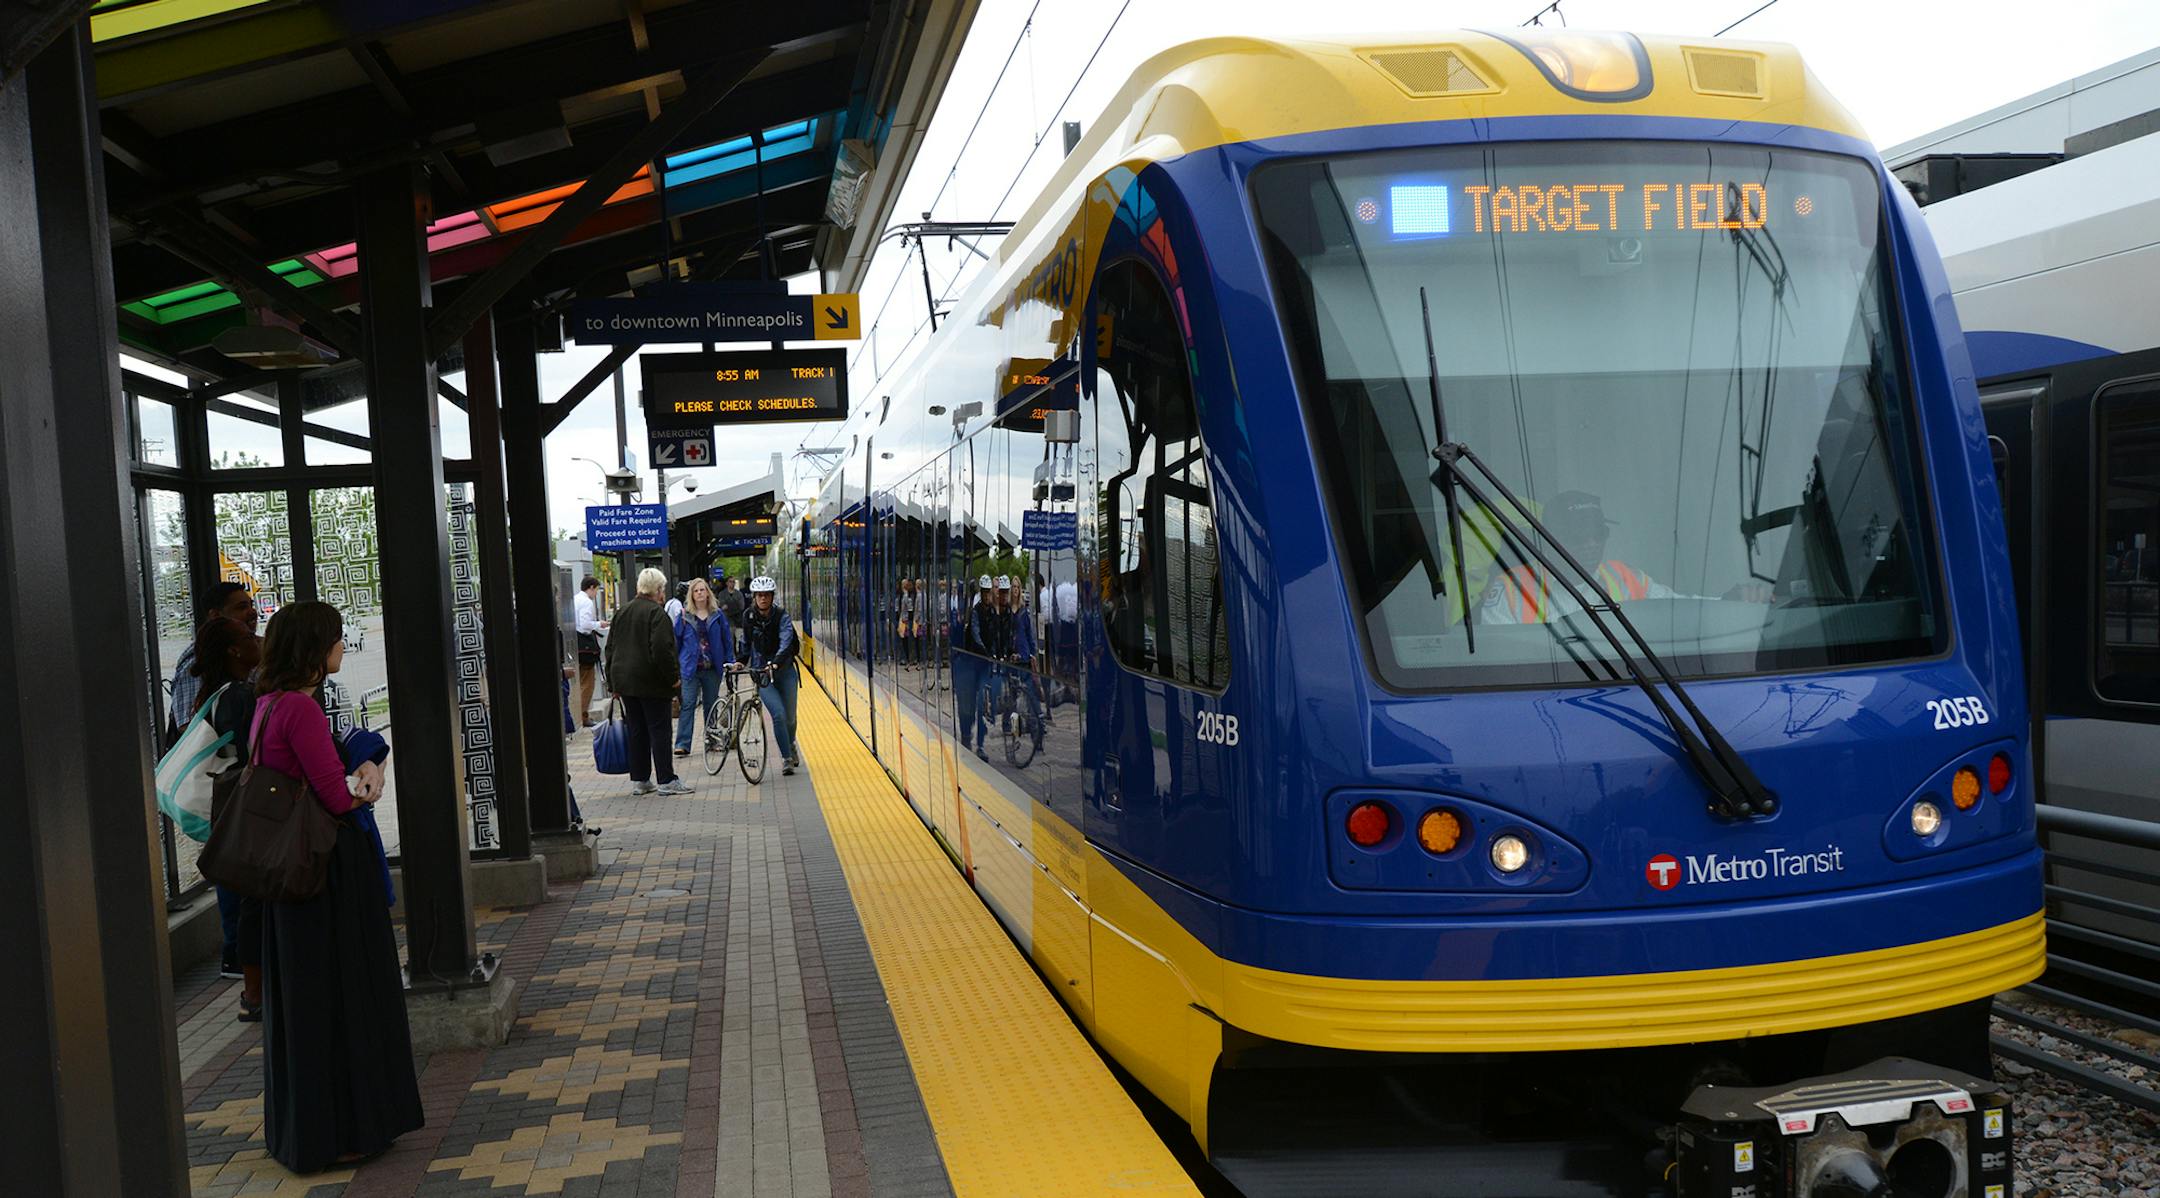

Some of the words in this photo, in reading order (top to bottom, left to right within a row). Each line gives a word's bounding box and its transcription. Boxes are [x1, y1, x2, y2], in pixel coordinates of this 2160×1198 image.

[1464, 184, 1624, 233] TARGET
[1643, 184, 1767, 231] FIELD
[585, 316, 604, 330] to
[610, 314, 700, 330] downtown
[706, 311, 804, 331] Minneapolis
[716, 369, 739, 382] 8:55
[744, 369, 760, 380] AM
[791, 367, 825, 379] TRACK
[674, 401, 714, 413] PLEASE
[719, 399, 753, 411] CHECK
[757, 397, 818, 410] SCHEDULES.
[651, 428, 711, 439] EMERGENCY
[598, 509, 615, 517] Paid
[616, 508, 633, 516] Fare
[634, 507, 655, 516] Zone
[591, 518, 610, 526] Valid
[611, 517, 628, 525] Fare
[628, 516, 662, 526] Required
[595, 529, 627, 538] Proceed
[638, 528, 660, 536] ticket
[601, 538, 632, 547] machine
[633, 537, 656, 546] ahead
[1926, 695, 1990, 731] 205B
[1197, 710, 1240, 747] 205B
